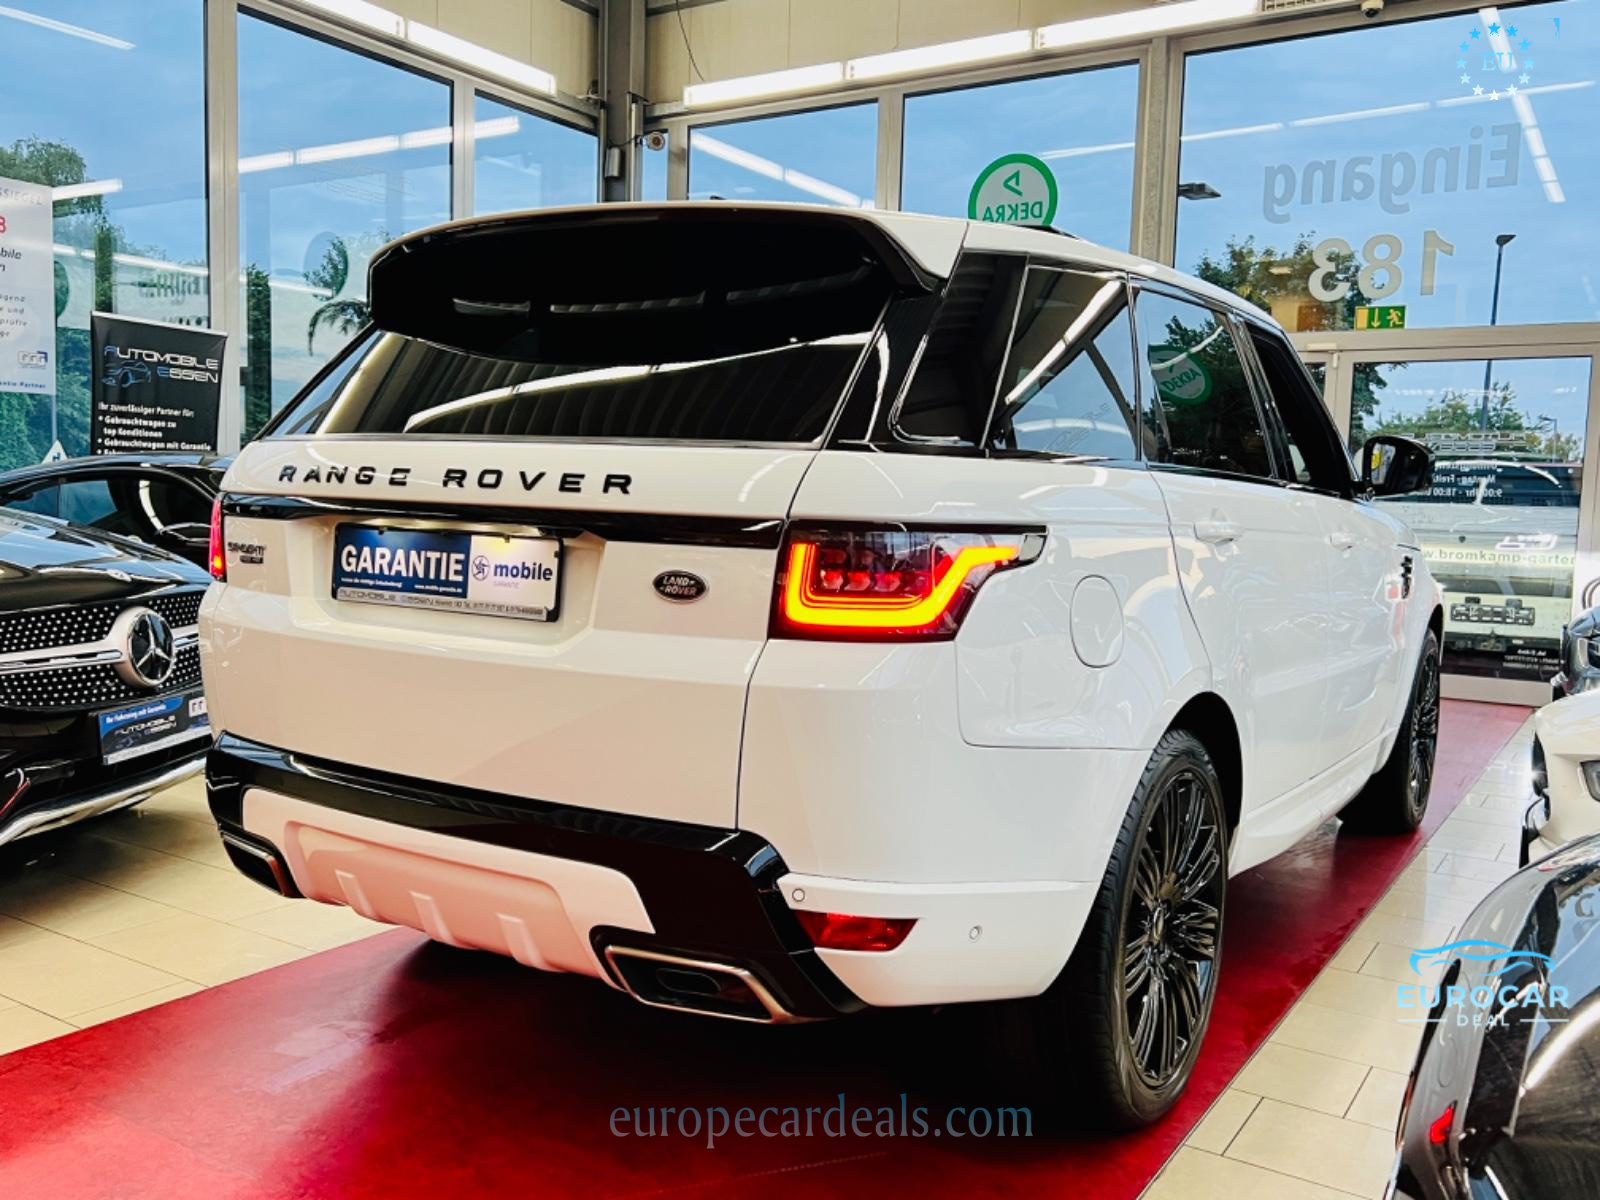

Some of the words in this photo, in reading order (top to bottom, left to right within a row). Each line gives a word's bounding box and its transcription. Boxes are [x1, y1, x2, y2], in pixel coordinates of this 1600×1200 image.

[104, 345, 219, 370] AUTOMOBILE
[157, 366, 218, 383] ESSEN
[1164, 368, 1202, 393] DEKRA
[156, 406, 181, 416] Partner
[104, 415, 166, 428] Gebrauchtwagen
[104, 438, 166, 450] Gebrauchtwagen
[278, 465, 411, 486] RANGE
[442, 468, 632, 495] ROVER
[341, 544, 466, 582] GARANTIE
[493, 561, 553, 581] mobile
[662, 575, 690, 586] LAND
[664, 585, 697, 595] ROVER
